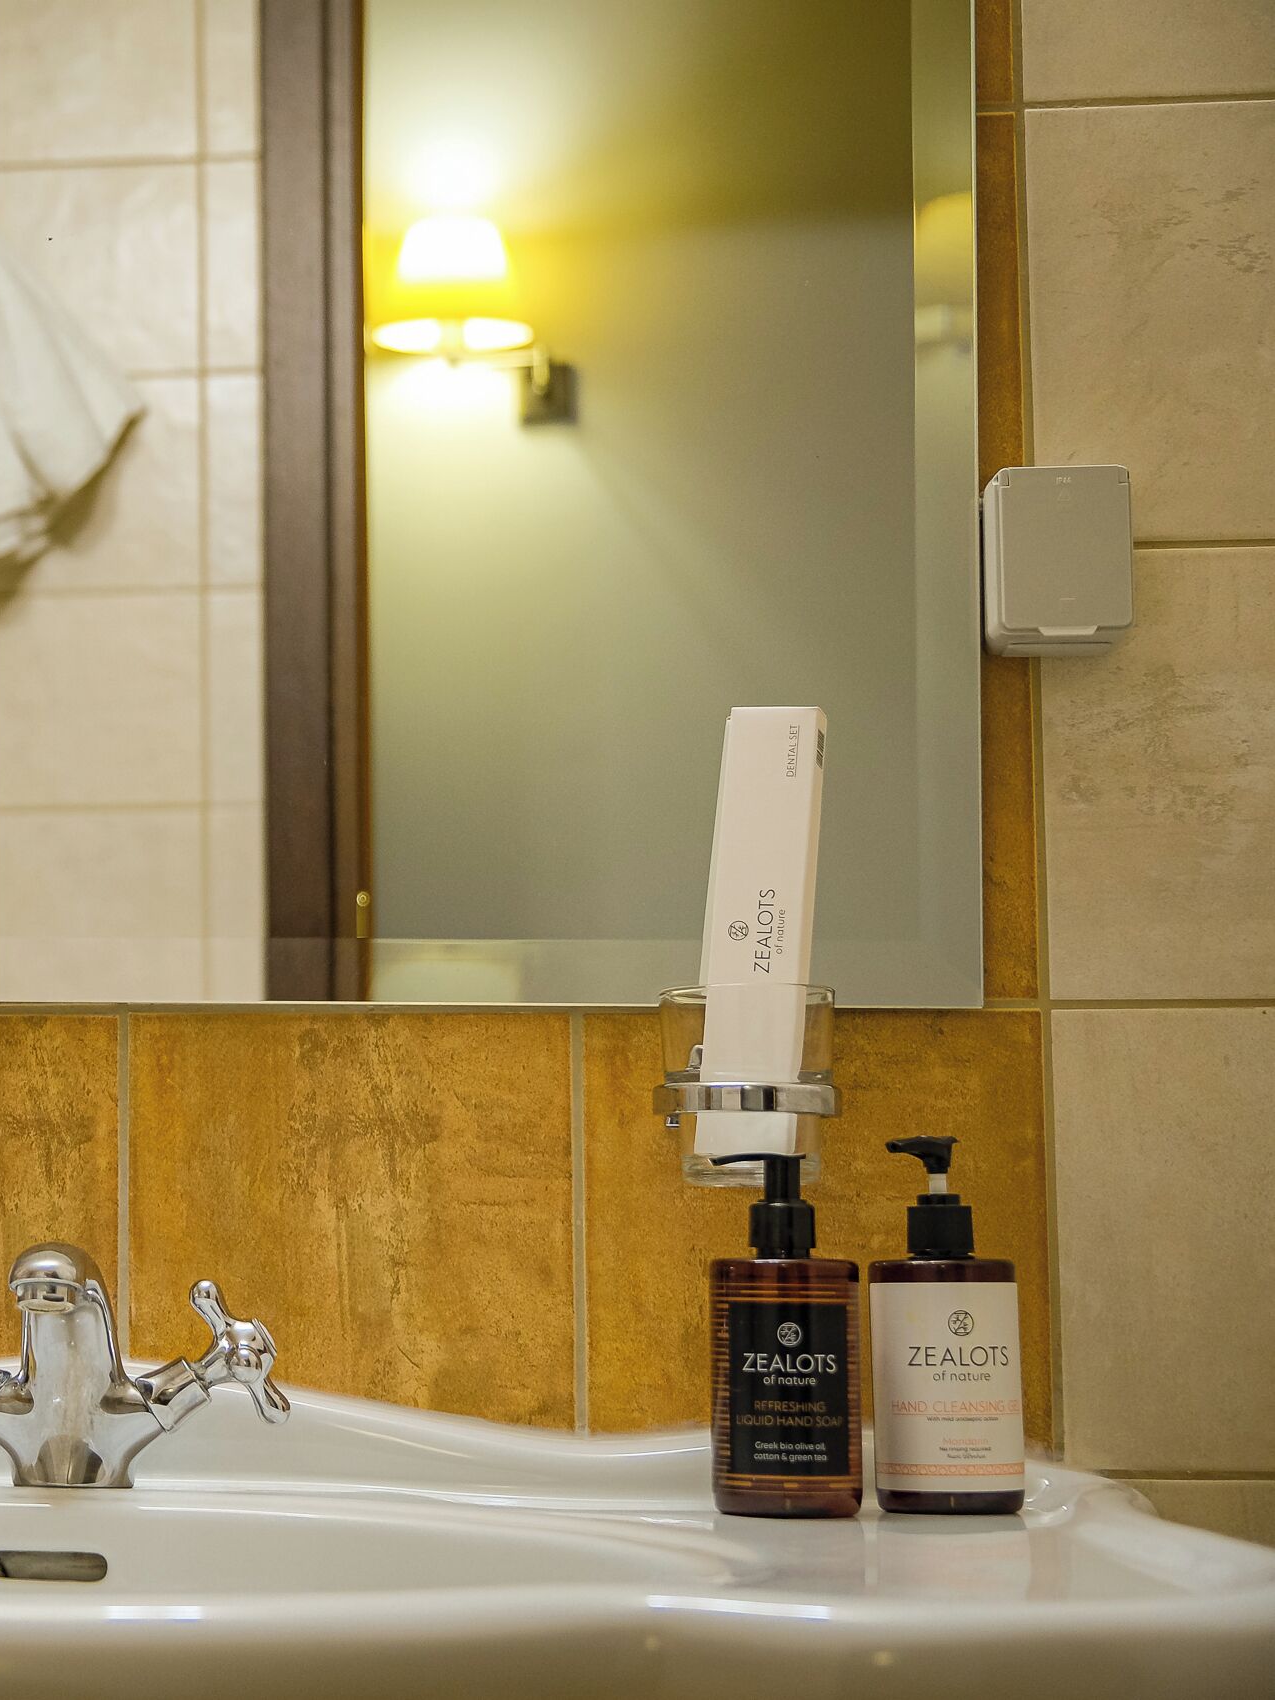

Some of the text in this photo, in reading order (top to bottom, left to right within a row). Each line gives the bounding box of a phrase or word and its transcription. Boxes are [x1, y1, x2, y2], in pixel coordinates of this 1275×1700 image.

[786, 724, 798, 777] DENTAL SET
[753, 889, 776, 974] ZEALOTS
[774, 909, 786, 955] of nature
[908, 1346, 1009, 1366] ZEALOTS
[742, 1353, 836, 1373] ZEALOTS
[763, 1374, 816, 1385] of nature
[933, 1370, 991, 1381] of nature
[754, 1400, 826, 1412] REFRESHING
[891, 1400, 927, 1413] HAND
[933, 1400, 1005, 1413] CLEANSING
[736, 1414, 843, 1427] LIQUID HAND SOAP
[754, 1441, 779, 1449] Greek
[779, 1441, 793, 1450] bio
[794, 1442, 814, 1450] olive
[754, 1452, 780, 1460] cotton
[788, 1454, 813, 1462] green
